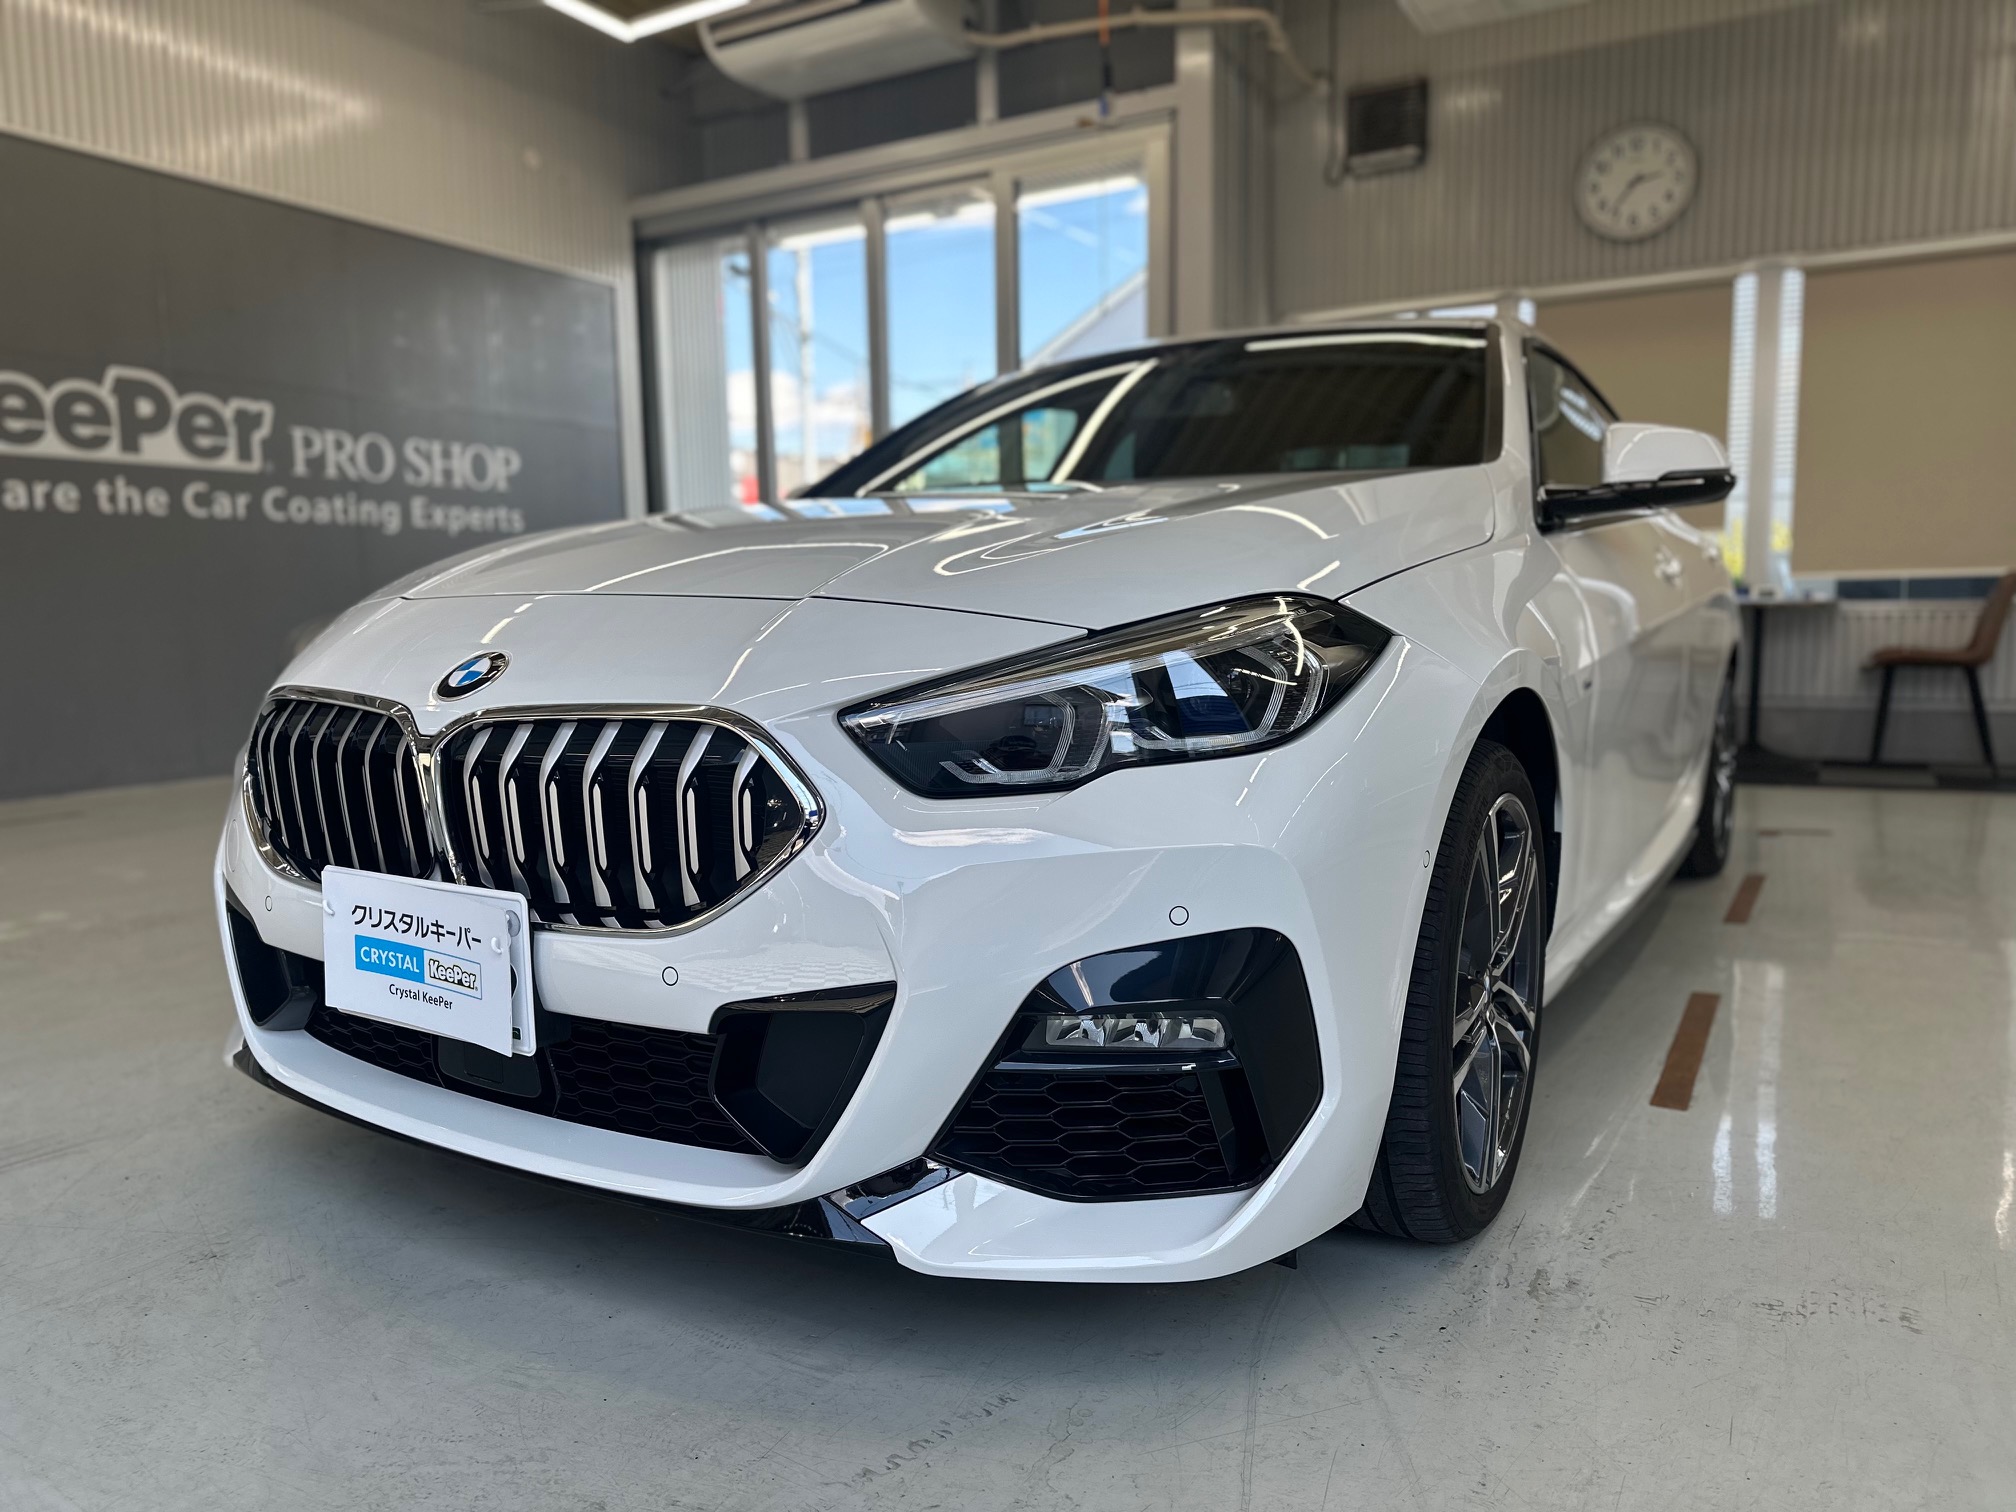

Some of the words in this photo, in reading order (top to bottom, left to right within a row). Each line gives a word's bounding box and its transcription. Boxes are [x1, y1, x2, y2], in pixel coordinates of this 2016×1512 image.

[0, 364, 274, 473] eePer
[290, 424, 395, 484] PRO
[403, 437, 522, 492] SHOP
[2, 477, 81, 513] are
[94, 475, 170, 517] the
[182, 481, 251, 521] Car
[261, 486, 401, 535] Coating
[410, 495, 525, 536] Experts
[352, 904, 482, 950] クリスタルキーパー
[360, 946, 420, 973] CRYSTAL
[429, 959, 477, 990] KeePer
[388, 983, 421, 1001] Crystal
[422, 991, 453, 1010] KeePer
